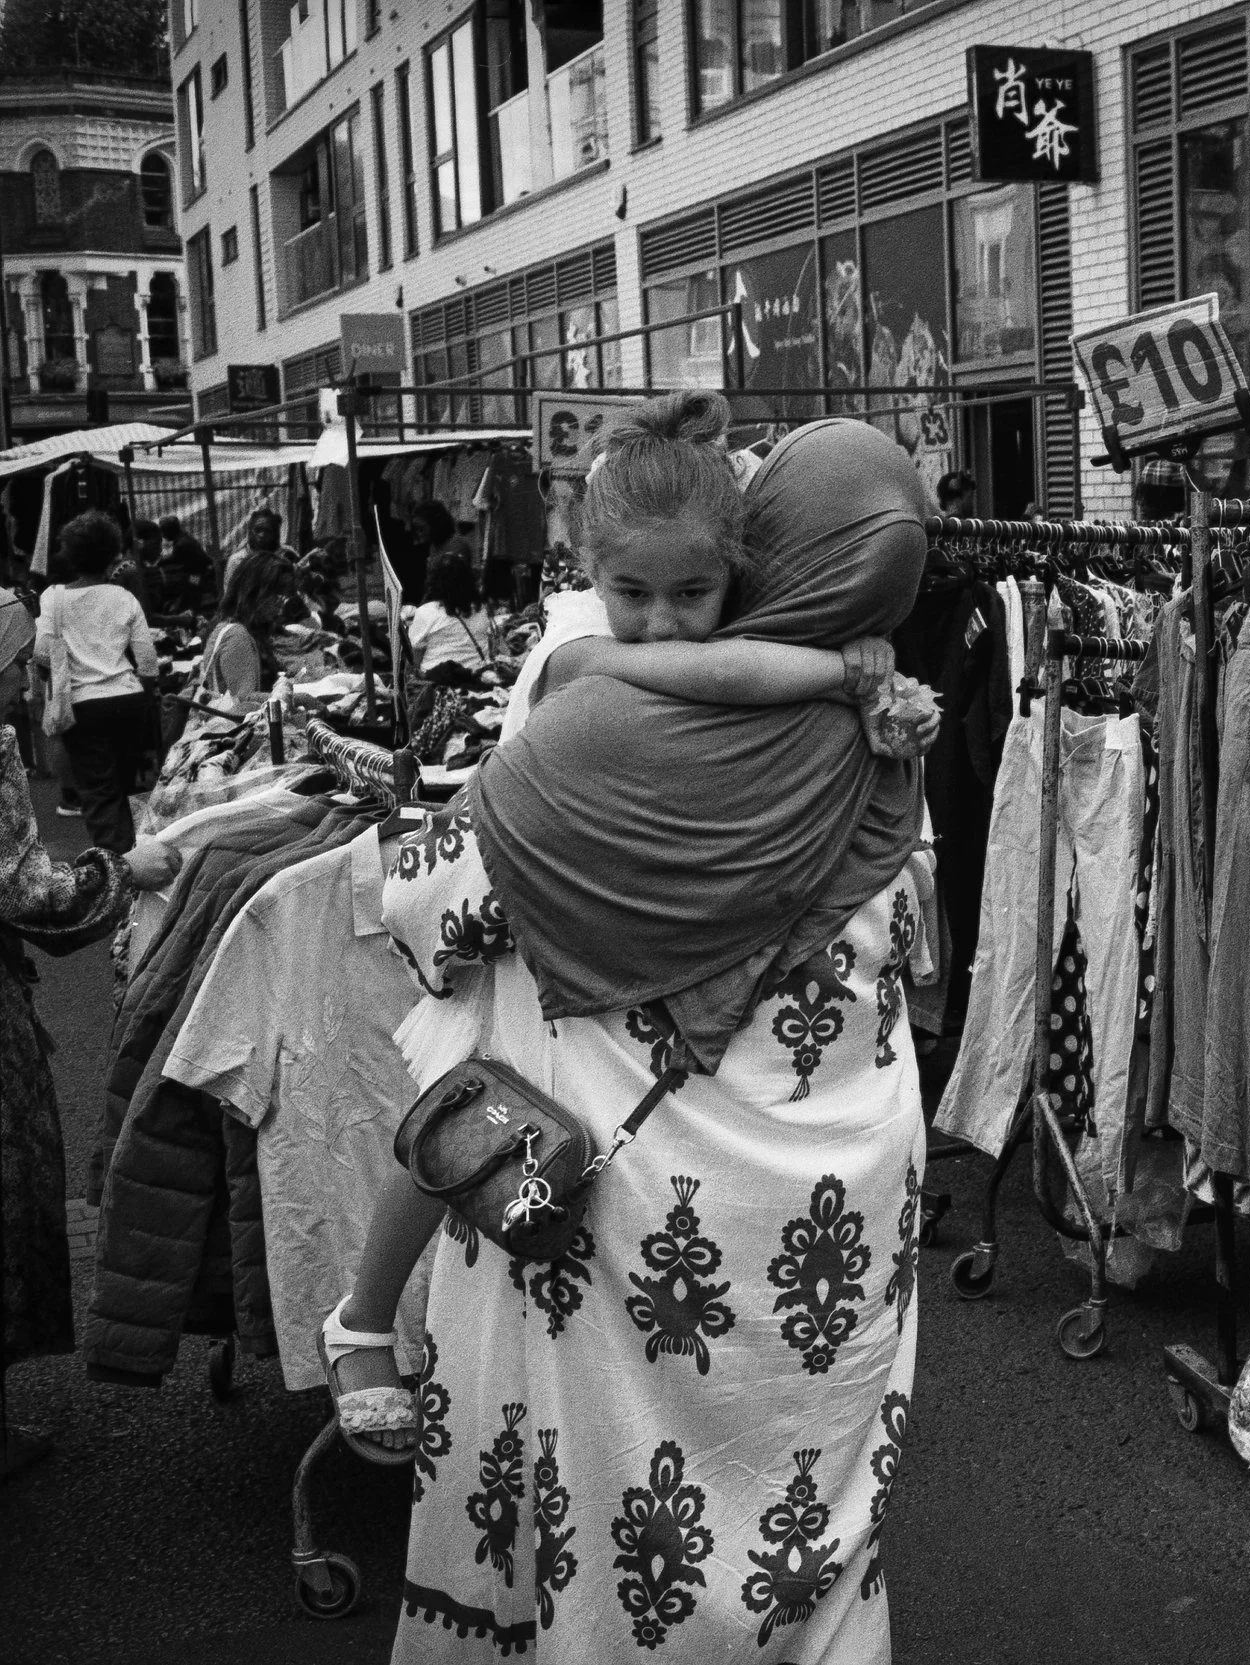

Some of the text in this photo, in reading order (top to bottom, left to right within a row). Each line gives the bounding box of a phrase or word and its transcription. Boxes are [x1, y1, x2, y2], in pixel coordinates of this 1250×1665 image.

[1035, 78, 1072, 90] YE YE
[1091, 318, 1222, 426] £10
